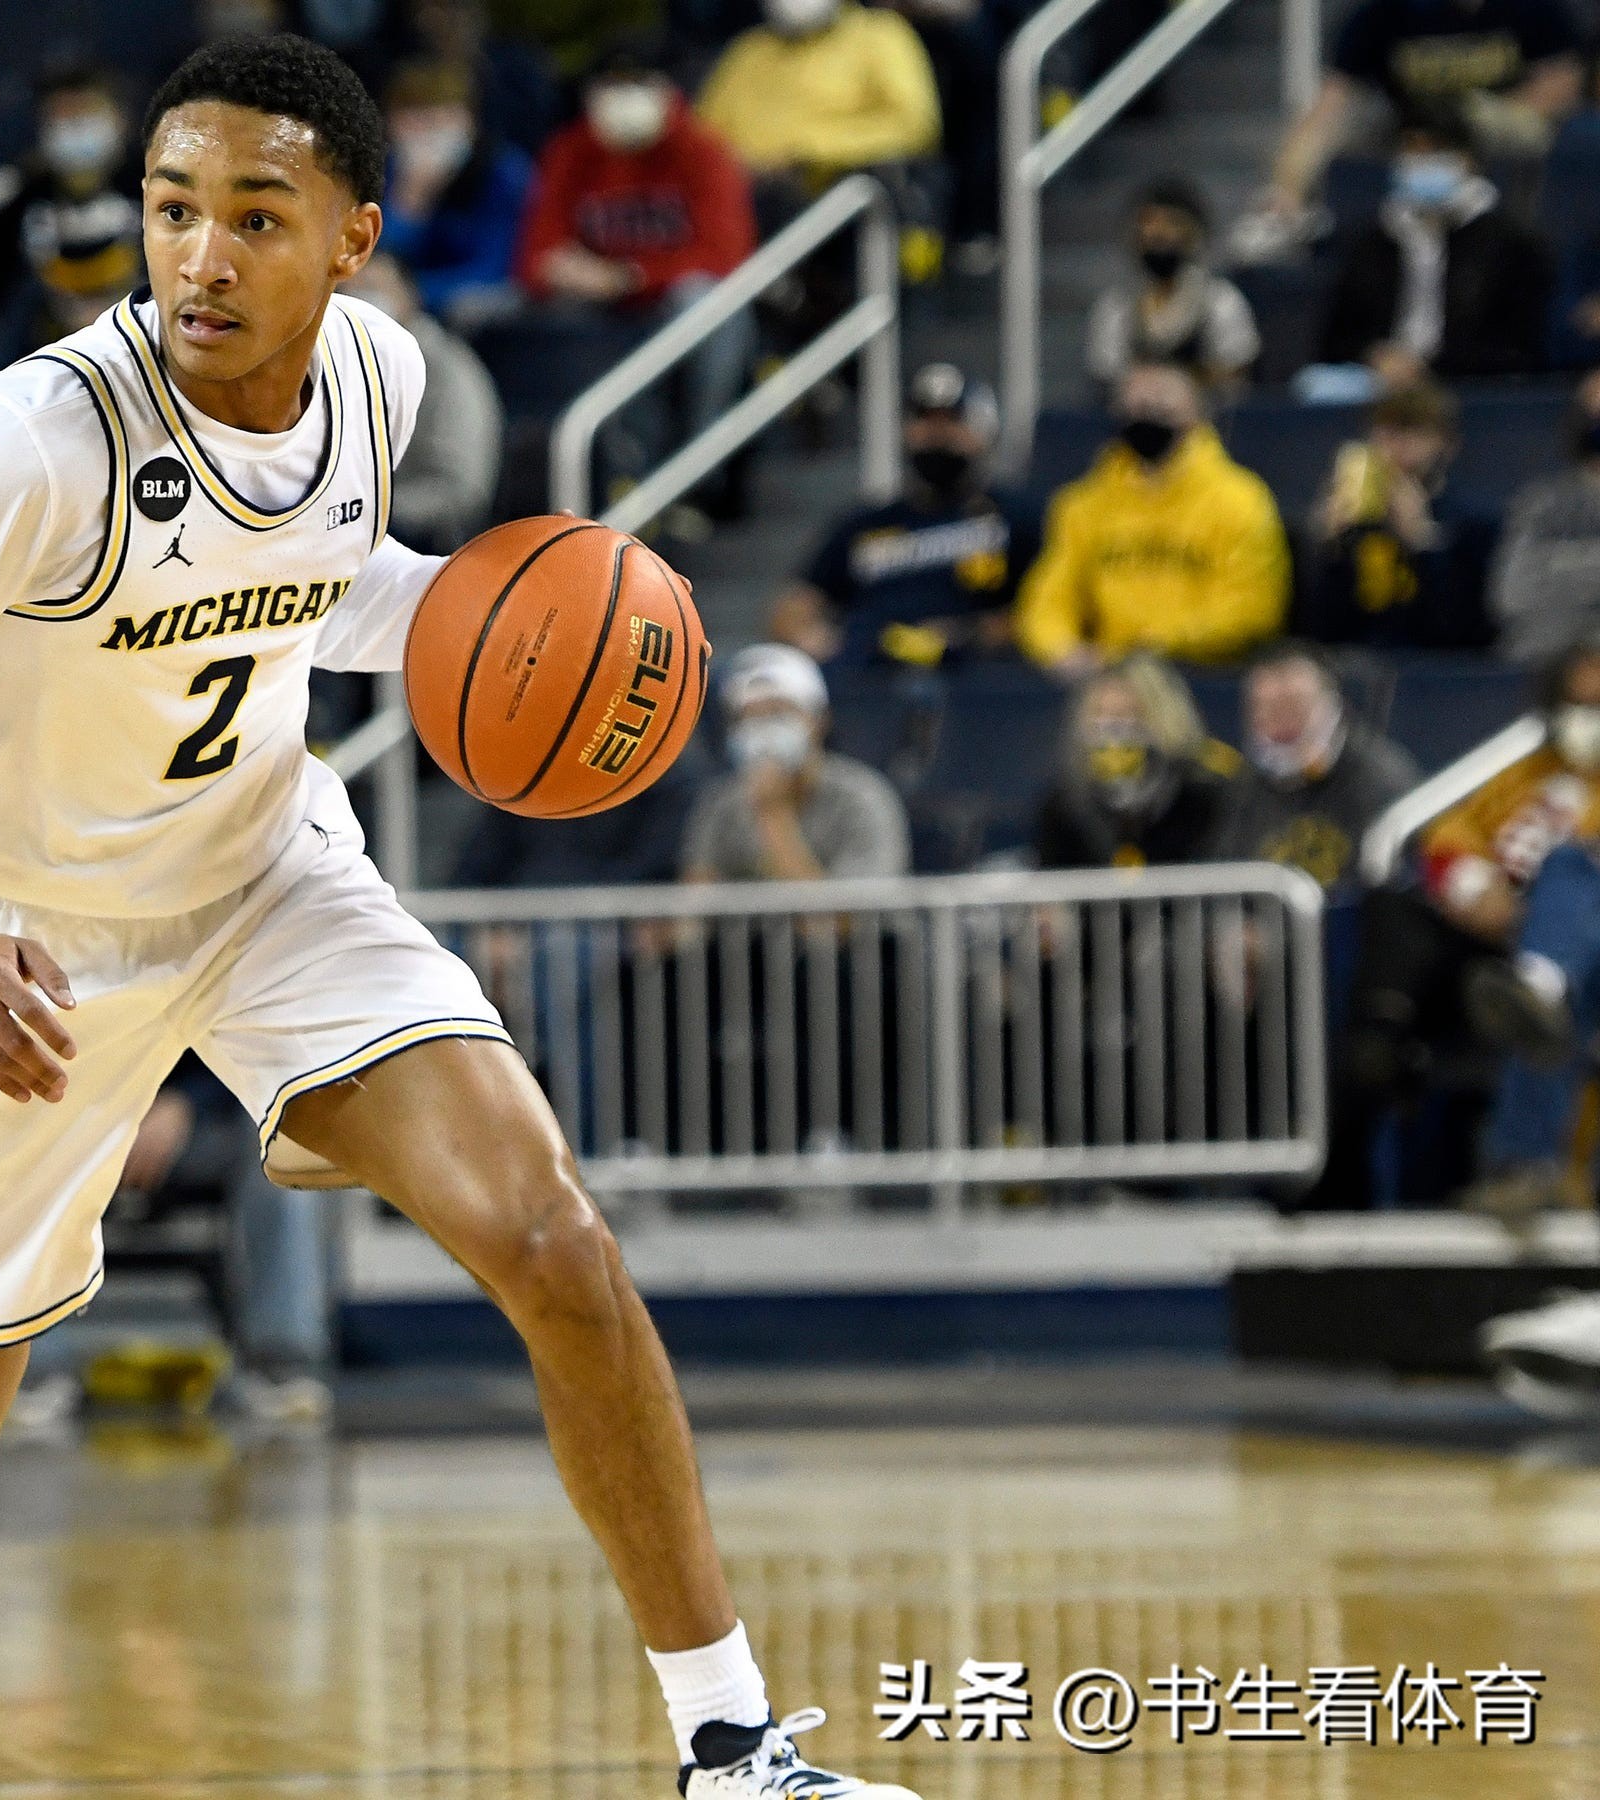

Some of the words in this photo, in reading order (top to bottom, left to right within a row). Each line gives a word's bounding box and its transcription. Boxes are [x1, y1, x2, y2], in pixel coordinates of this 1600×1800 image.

[141, 479, 185, 498] BLM
[162, 653, 257, 781] 2
[586, 617, 674, 776] ELITE
